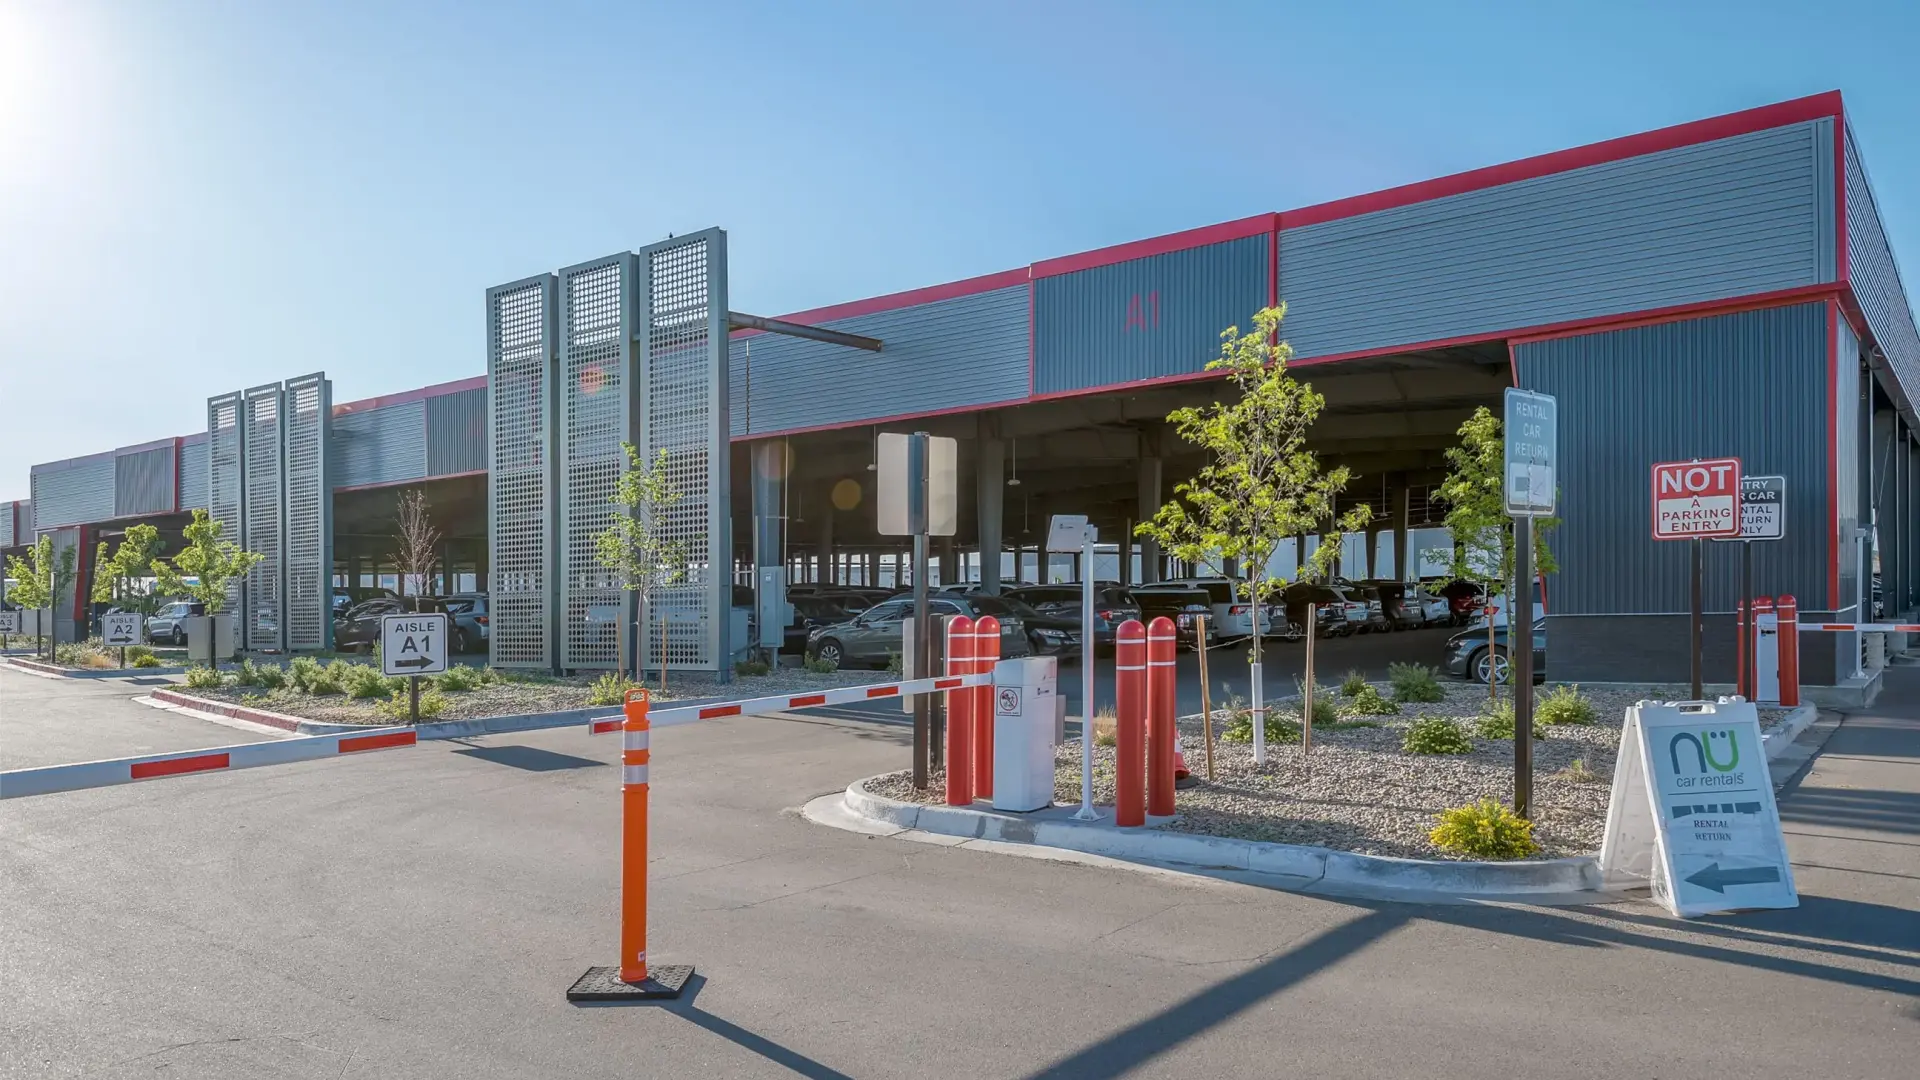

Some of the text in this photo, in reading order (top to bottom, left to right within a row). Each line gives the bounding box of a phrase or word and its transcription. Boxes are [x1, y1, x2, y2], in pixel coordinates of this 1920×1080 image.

[1123, 290, 1159, 333] A1
[1516, 401, 1548, 420] RENTAL
[1523, 423, 1541, 438] CAR
[1515, 442, 1548, 459] RETURN
[1661, 465, 1732, 494] NOT
[1740, 480, 1769, 490] TRY
[1748, 491, 1776, 501] CAR
[1691, 499, 1701, 508] A
[1662, 508, 1731, 521] PARKING
[1741, 505, 1773, 514] NTAL
[1740, 515, 1772, 524] TURN
[1671, 520, 1722, 532] ENTRY
[1741, 525, 1763, 534] NLY
[114, 624, 133, 635] A2
[395, 622, 435, 633] AISLE
[401, 635, 430, 654] A1
[1676, 773, 1744, 788] car rentals
[1694, 820, 1729, 829] RENTAL
[1695, 832, 1732, 842] RETURN
